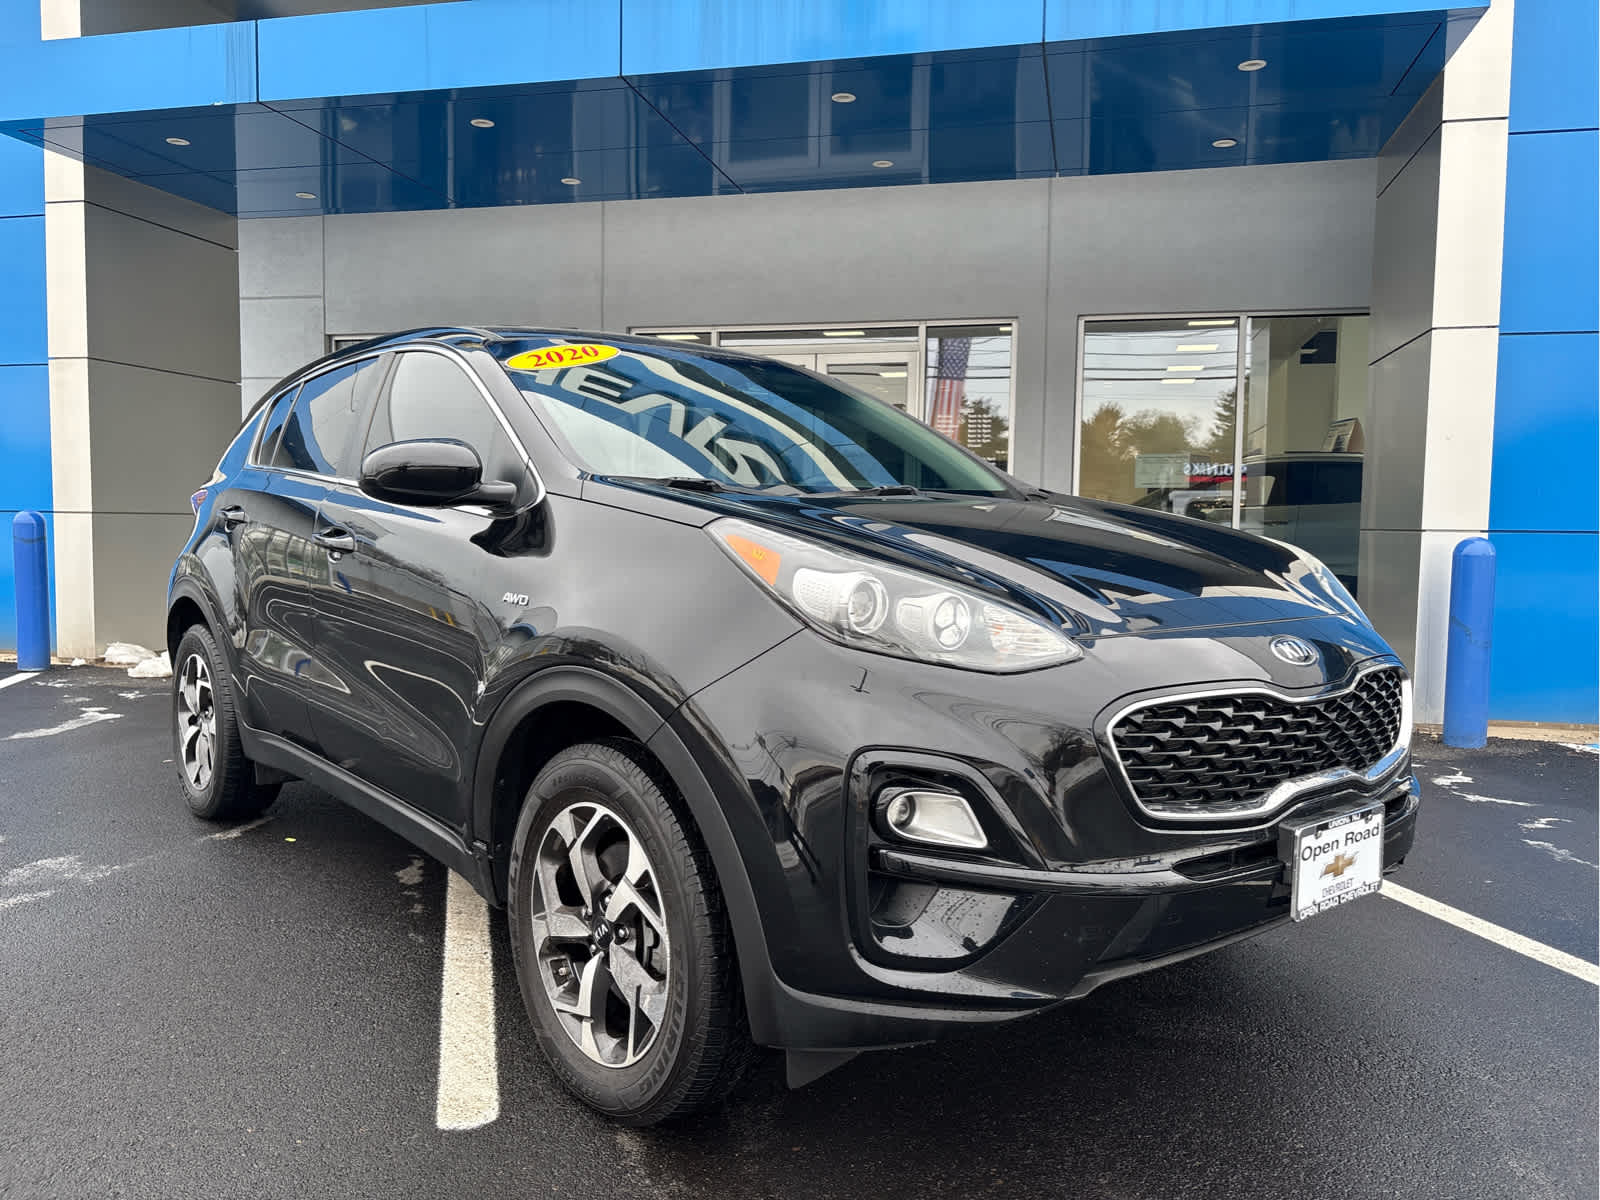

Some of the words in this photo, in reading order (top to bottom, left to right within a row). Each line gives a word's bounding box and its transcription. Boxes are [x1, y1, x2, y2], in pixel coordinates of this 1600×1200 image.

[527, 346, 599, 367] 2020
[503, 592, 529, 605] AWD
[1301, 839, 1339, 862] Open
[1344, 821, 1380, 847] Road
[1320, 895, 1339, 912] ROAD
[1340, 881, 1380, 903] CHEVROLET
[1321, 877, 1354, 898] CHEVROLET
[594, 923, 609, 942] KIA
